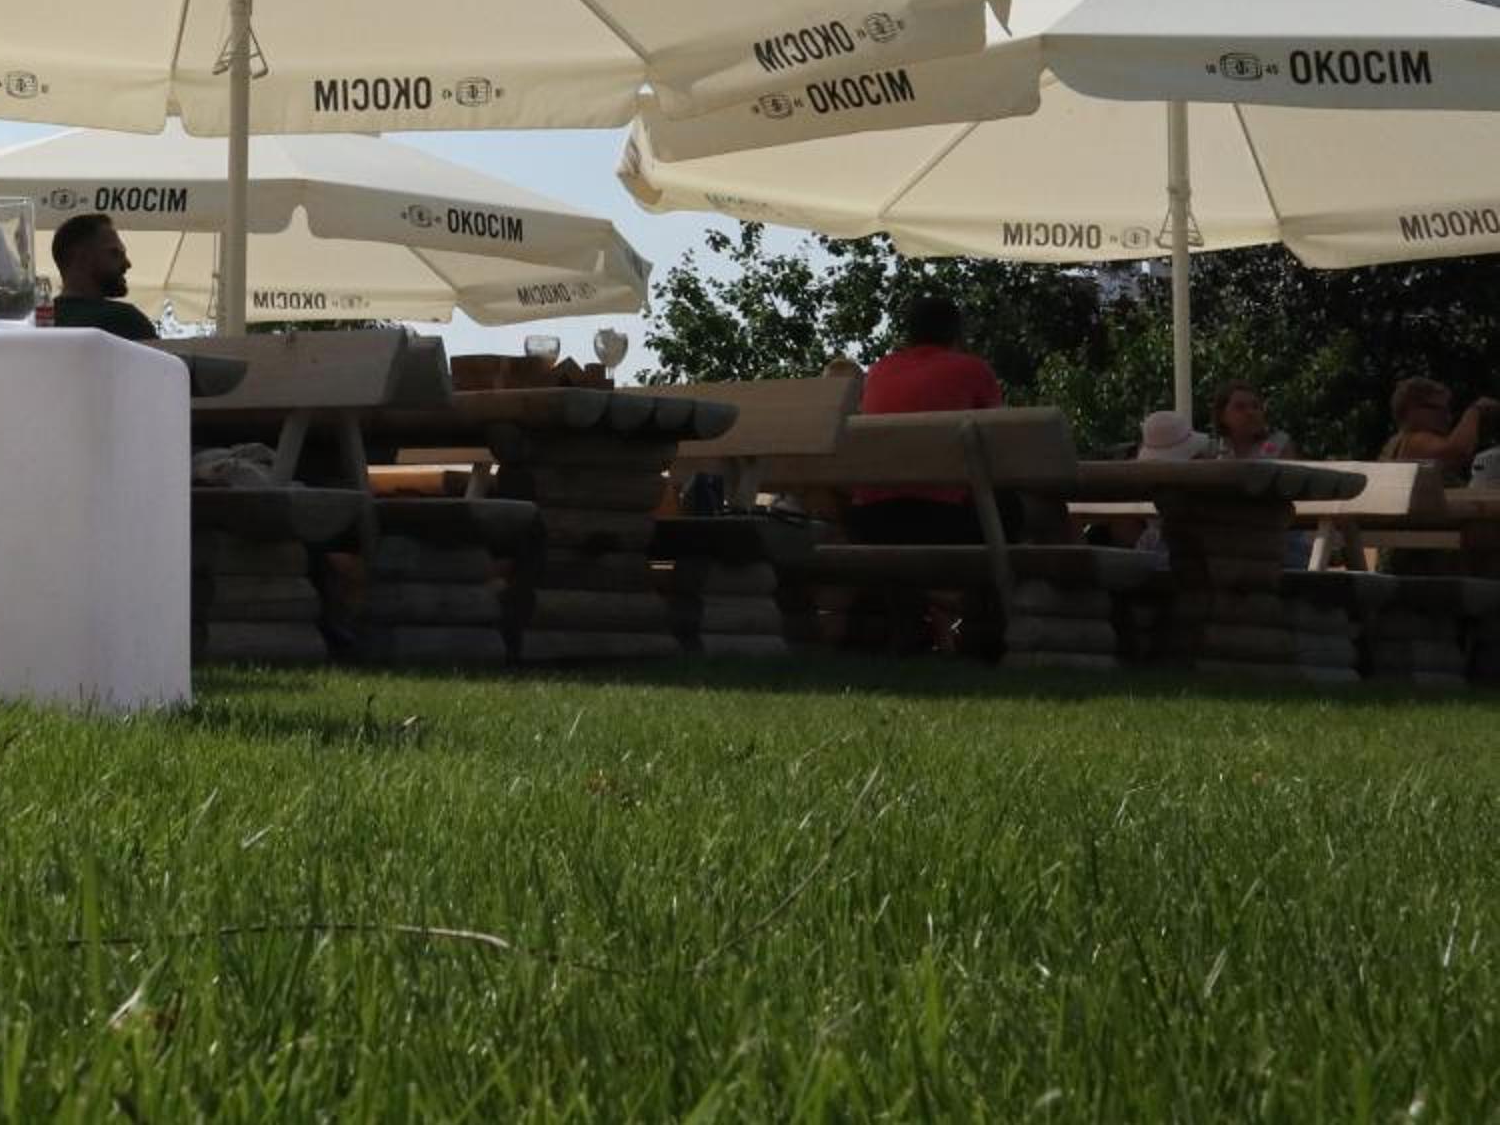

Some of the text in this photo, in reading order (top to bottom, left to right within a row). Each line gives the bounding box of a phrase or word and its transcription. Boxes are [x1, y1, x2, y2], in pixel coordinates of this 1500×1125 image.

[1289, 49, 1434, 85] OKOCIM
[806, 68, 916, 115] OKOCIM
[95, 186, 189, 213] OKOCIM
[446, 207, 524, 243] OKOCIM
